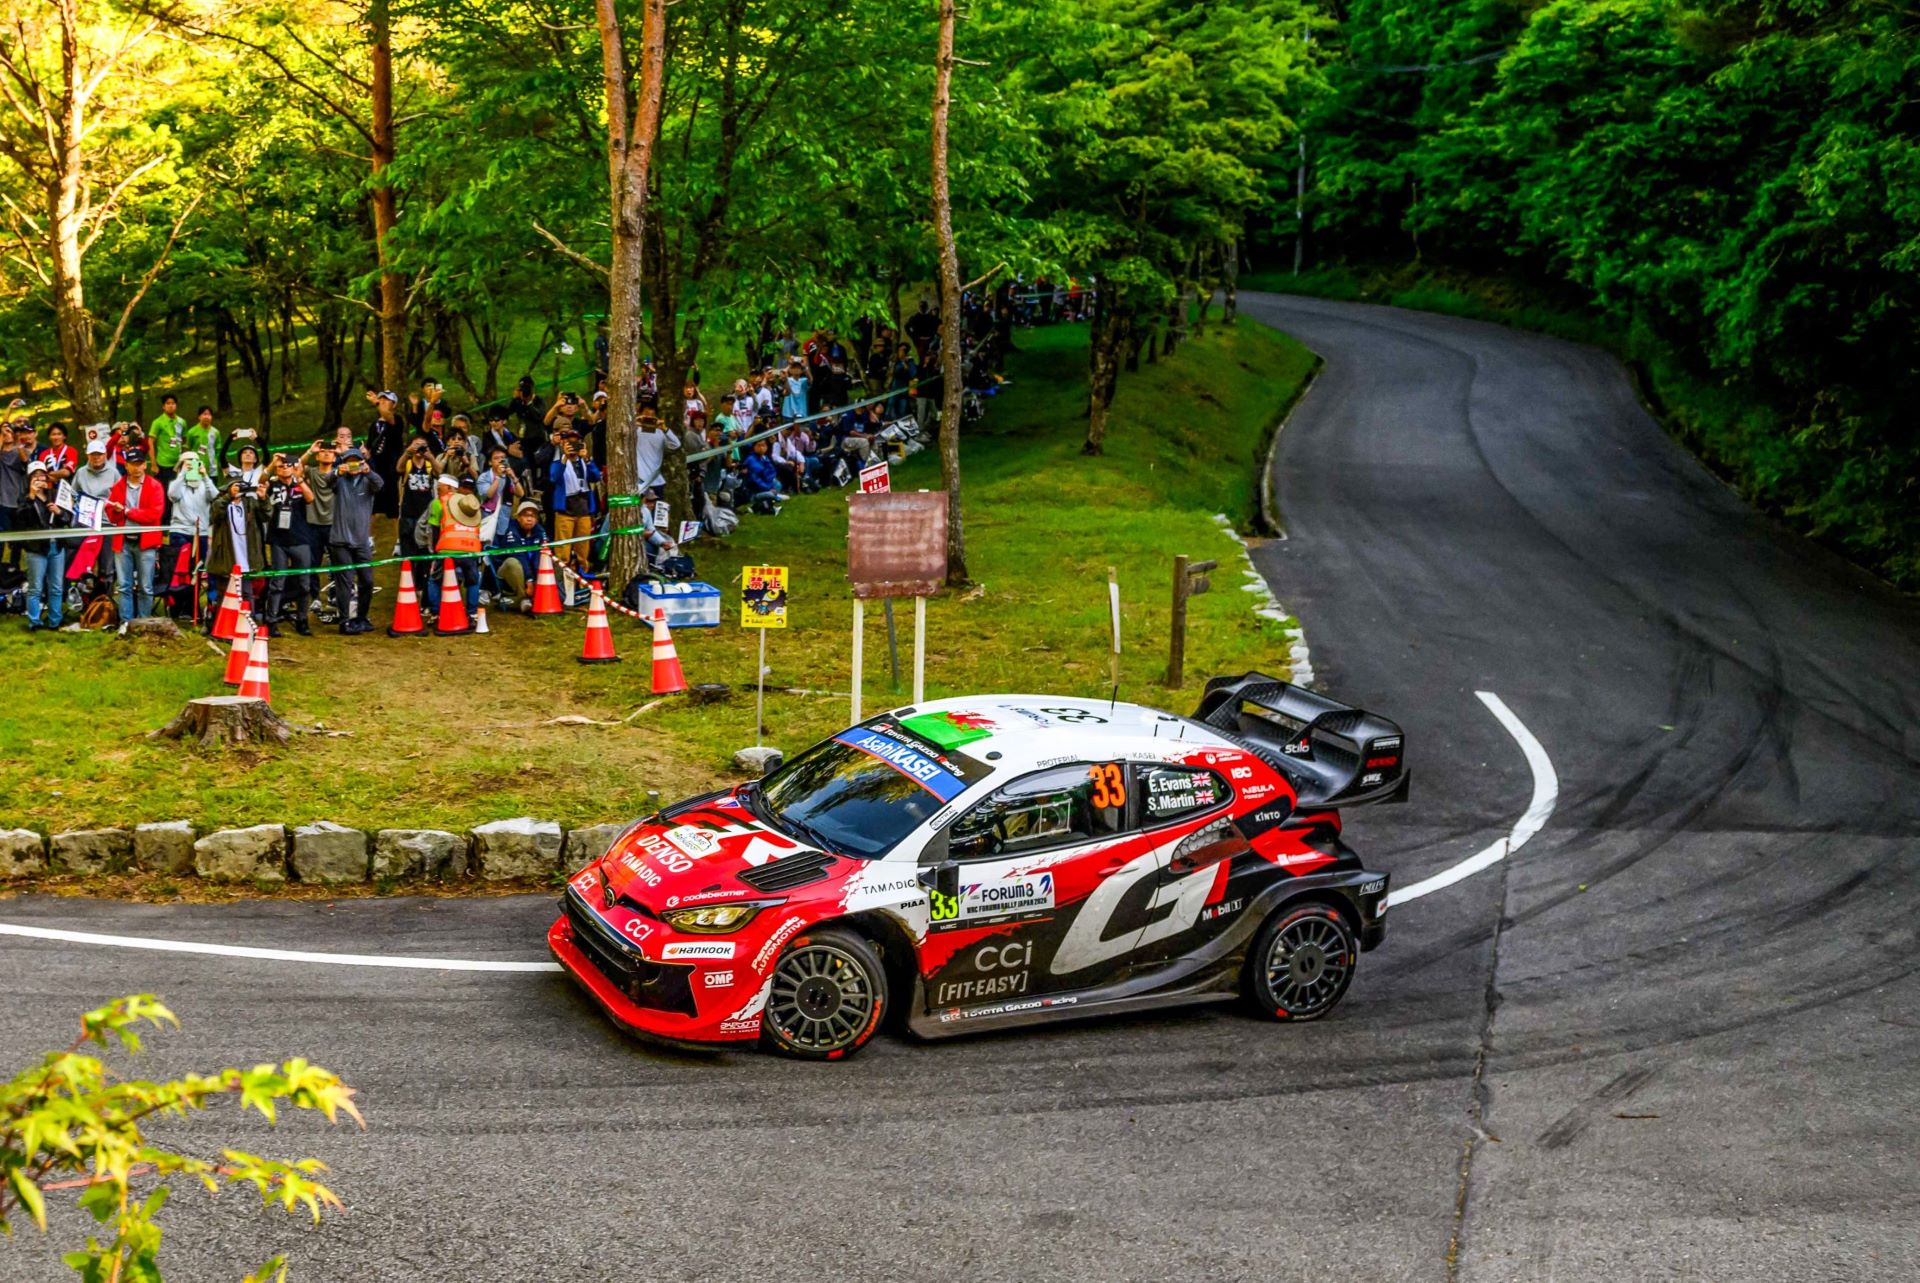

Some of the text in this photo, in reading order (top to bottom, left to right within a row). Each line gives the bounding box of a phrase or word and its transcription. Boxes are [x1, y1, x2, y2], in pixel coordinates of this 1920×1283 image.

[750, 576, 782, 590] 禁止
[885, 729, 912, 744] TOYOTA
[909, 740, 939, 758] GAZOO
[936, 755, 965, 776] Racing
[1088, 762, 1126, 809] 33
[1149, 777, 1192, 793] E.Evans
[1148, 794, 1195, 811] S.Martin
[636, 834, 693, 873] DENSO
[620, 852, 662, 887] TAMADIC
[682, 890, 749, 902] codebeamer
[863, 879, 915, 895] TAMADIC
[982, 883, 1034, 902] FORUM8
[900, 900, 925, 909] PIAA
[931, 890, 959, 920] 33
[1001, 900, 1017, 909] RALLY
[1018, 899, 1034, 907] JAPAN
[1203, 903, 1230, 920] Mobil
[752, 916, 800, 970] Panasonic
[758, 919, 808, 976] AUTOMOTIVE
[704, 972, 734, 986] OMP
[963, 1006, 1003, 1018] TOYOTA
[1005, 1000, 1042, 1013] GAZOO
[1042, 996, 1078, 1008] Racing
